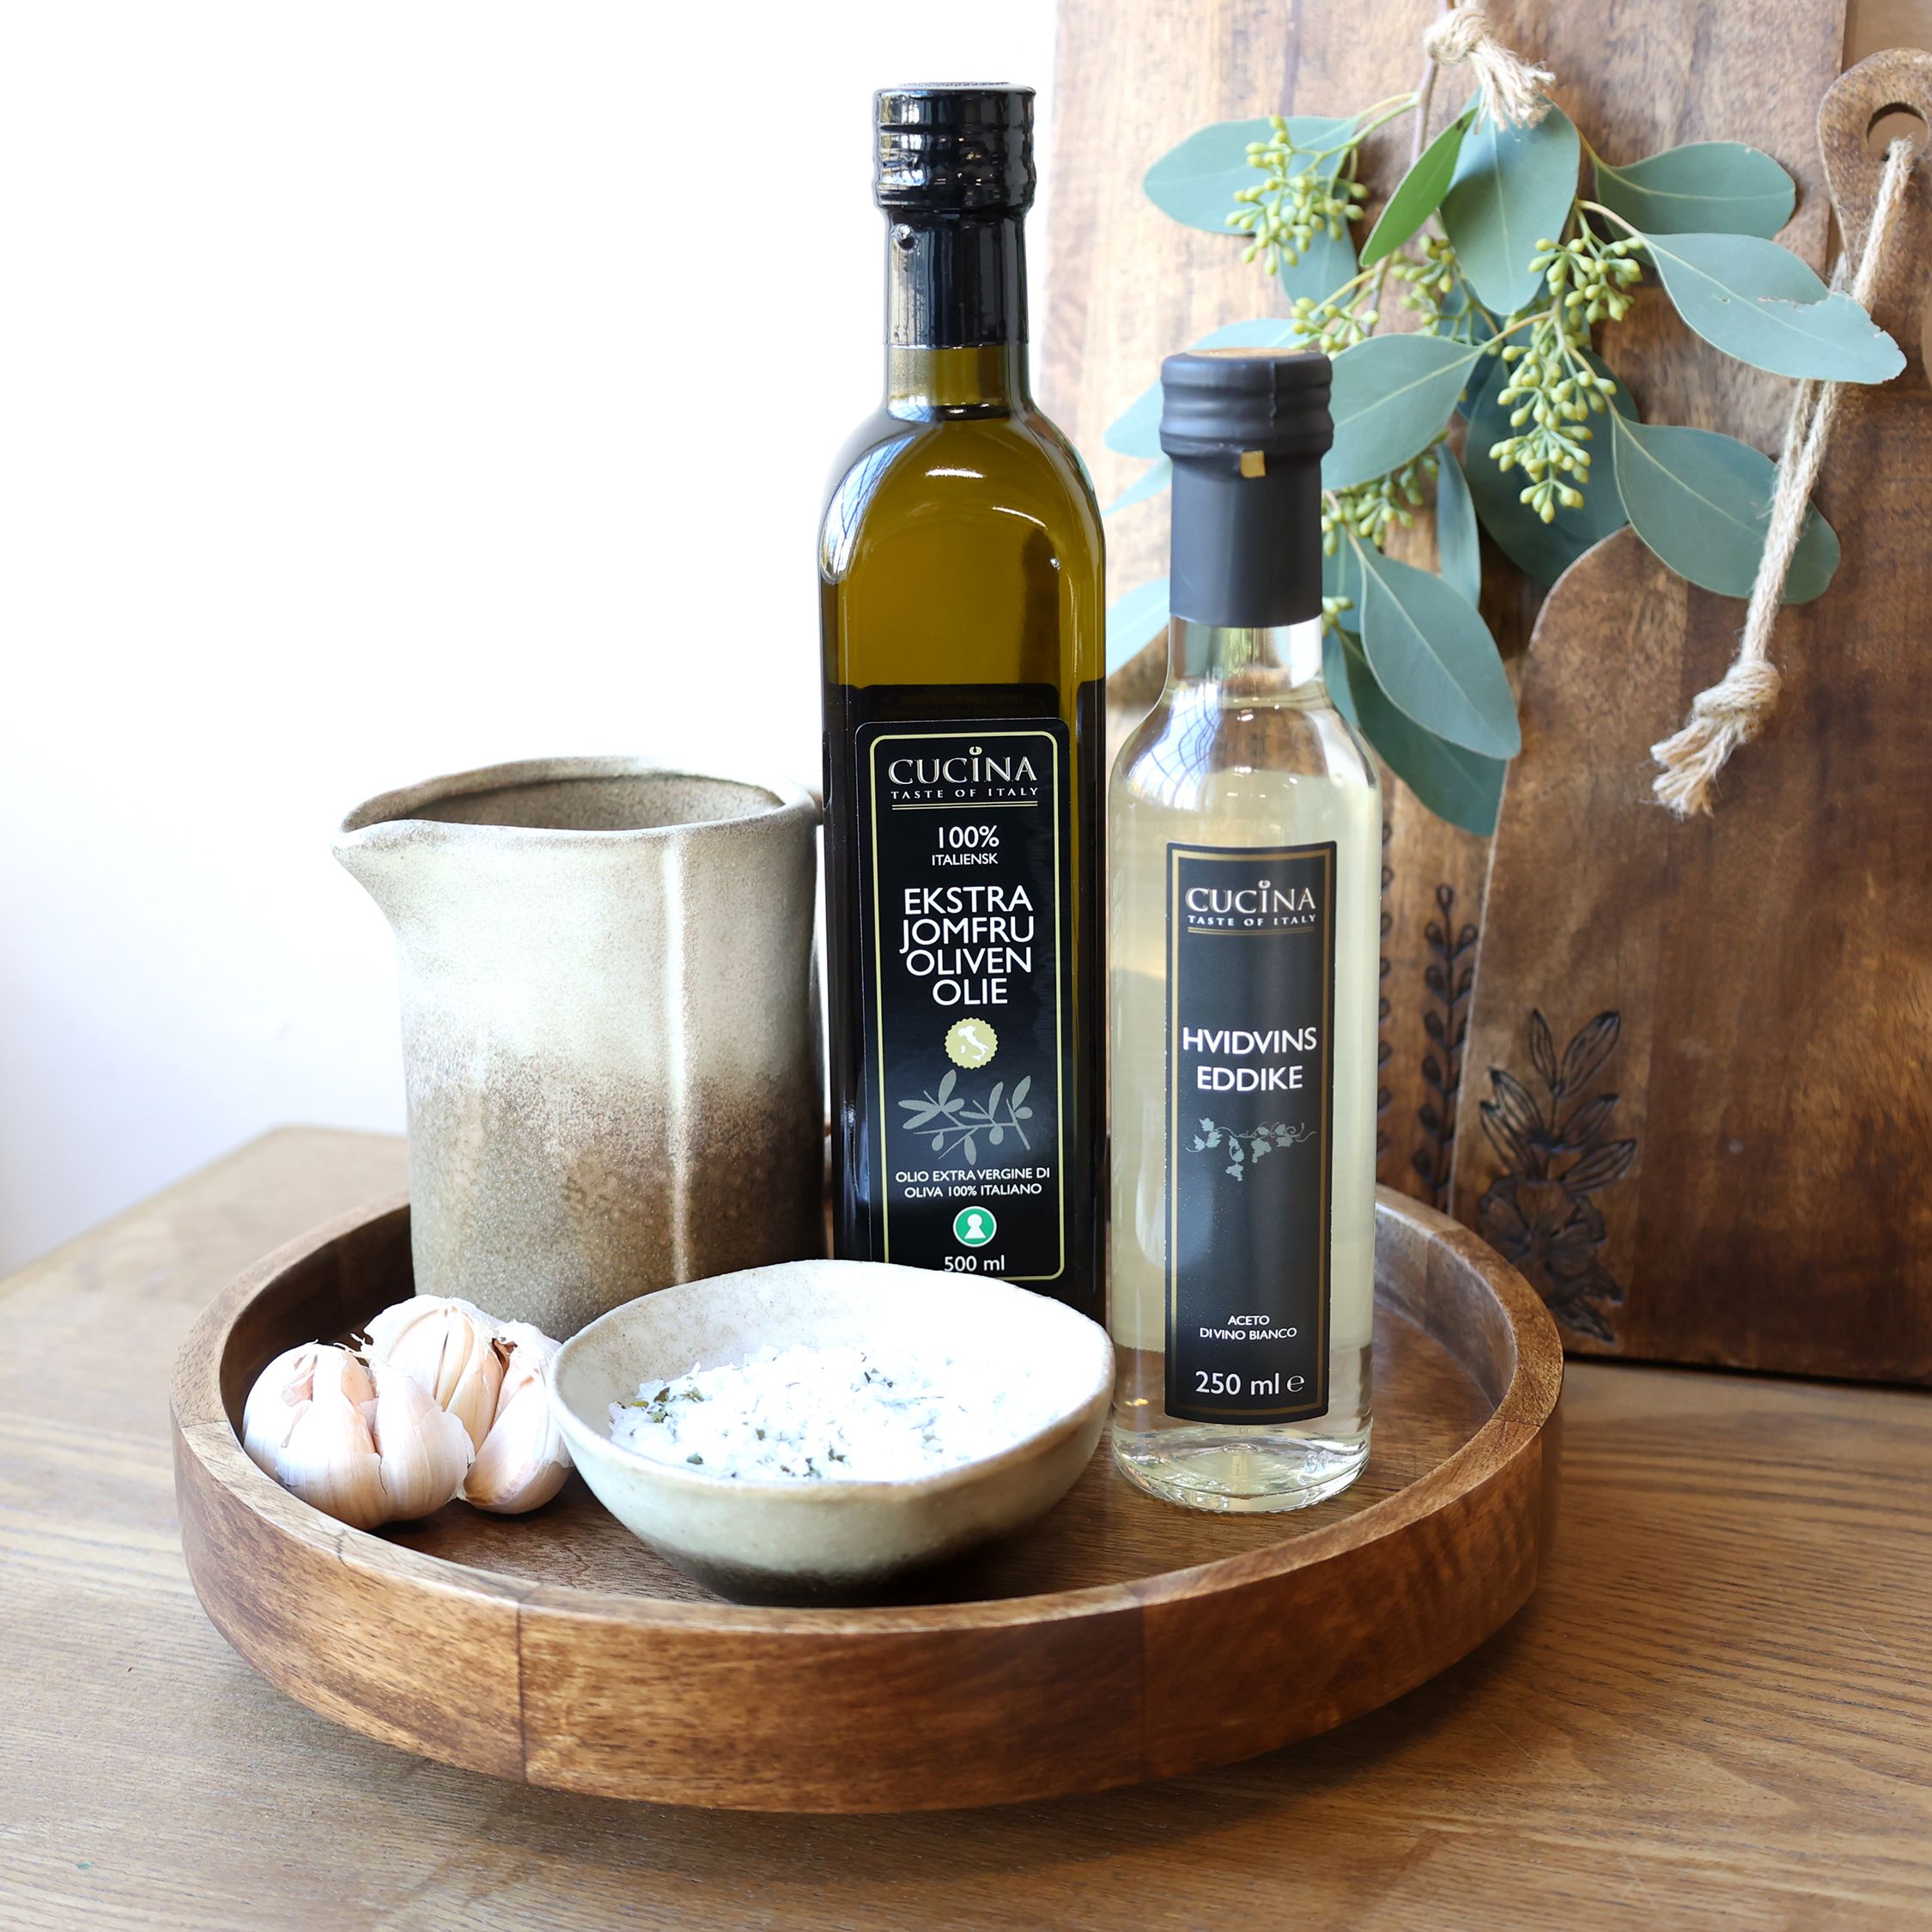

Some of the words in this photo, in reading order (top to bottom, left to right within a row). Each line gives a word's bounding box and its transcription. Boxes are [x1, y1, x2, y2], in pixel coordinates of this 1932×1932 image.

[890, 789, 945, 800] TASTE
[955, 787, 977, 798] OF
[987, 787, 1039, 797] ITALY
[938, 825, 1000, 849] 100%
[932, 853, 999, 867] ITALIENSK
[904, 884, 1034, 915] EKSTRA
[1187, 914, 1235, 927] TASTE
[1243, 917, 1264, 927] OF
[1273, 914, 1316, 926] ITALY
[899, 915, 1035, 954] JOMFRU
[906, 946, 1032, 976] OLIVEN
[933, 977, 1009, 1005] OLIE
[1182, 1026, 1318, 1055] HVIDVINS
[1196, 1065, 1303, 1092] EDDIKE
[895, 1170, 929, 1182] OLIO
[933, 1170, 976, 1182] EXTRA
[976, 1168, 1033, 1181] VERGINE
[1036, 1167, 1050, 1179] DI
[904, 1185, 944, 1199] OLIVA
[948, 1184, 977, 1197] 100%
[981, 1182, 1042, 1195] ITALIANO
[944, 1255, 977, 1272] 500
[983, 1254, 1005, 1271] ml
[1227, 1315, 1270, 1326] ACETO
[1200, 1327, 1212, 1338] DI
[1212, 1328, 1246, 1340] VINO
[1249, 1327, 1297, 1340] BIANCO
[1195, 1370, 1242, 1395] 250
[1250, 1372, 1280, 1395] ml
